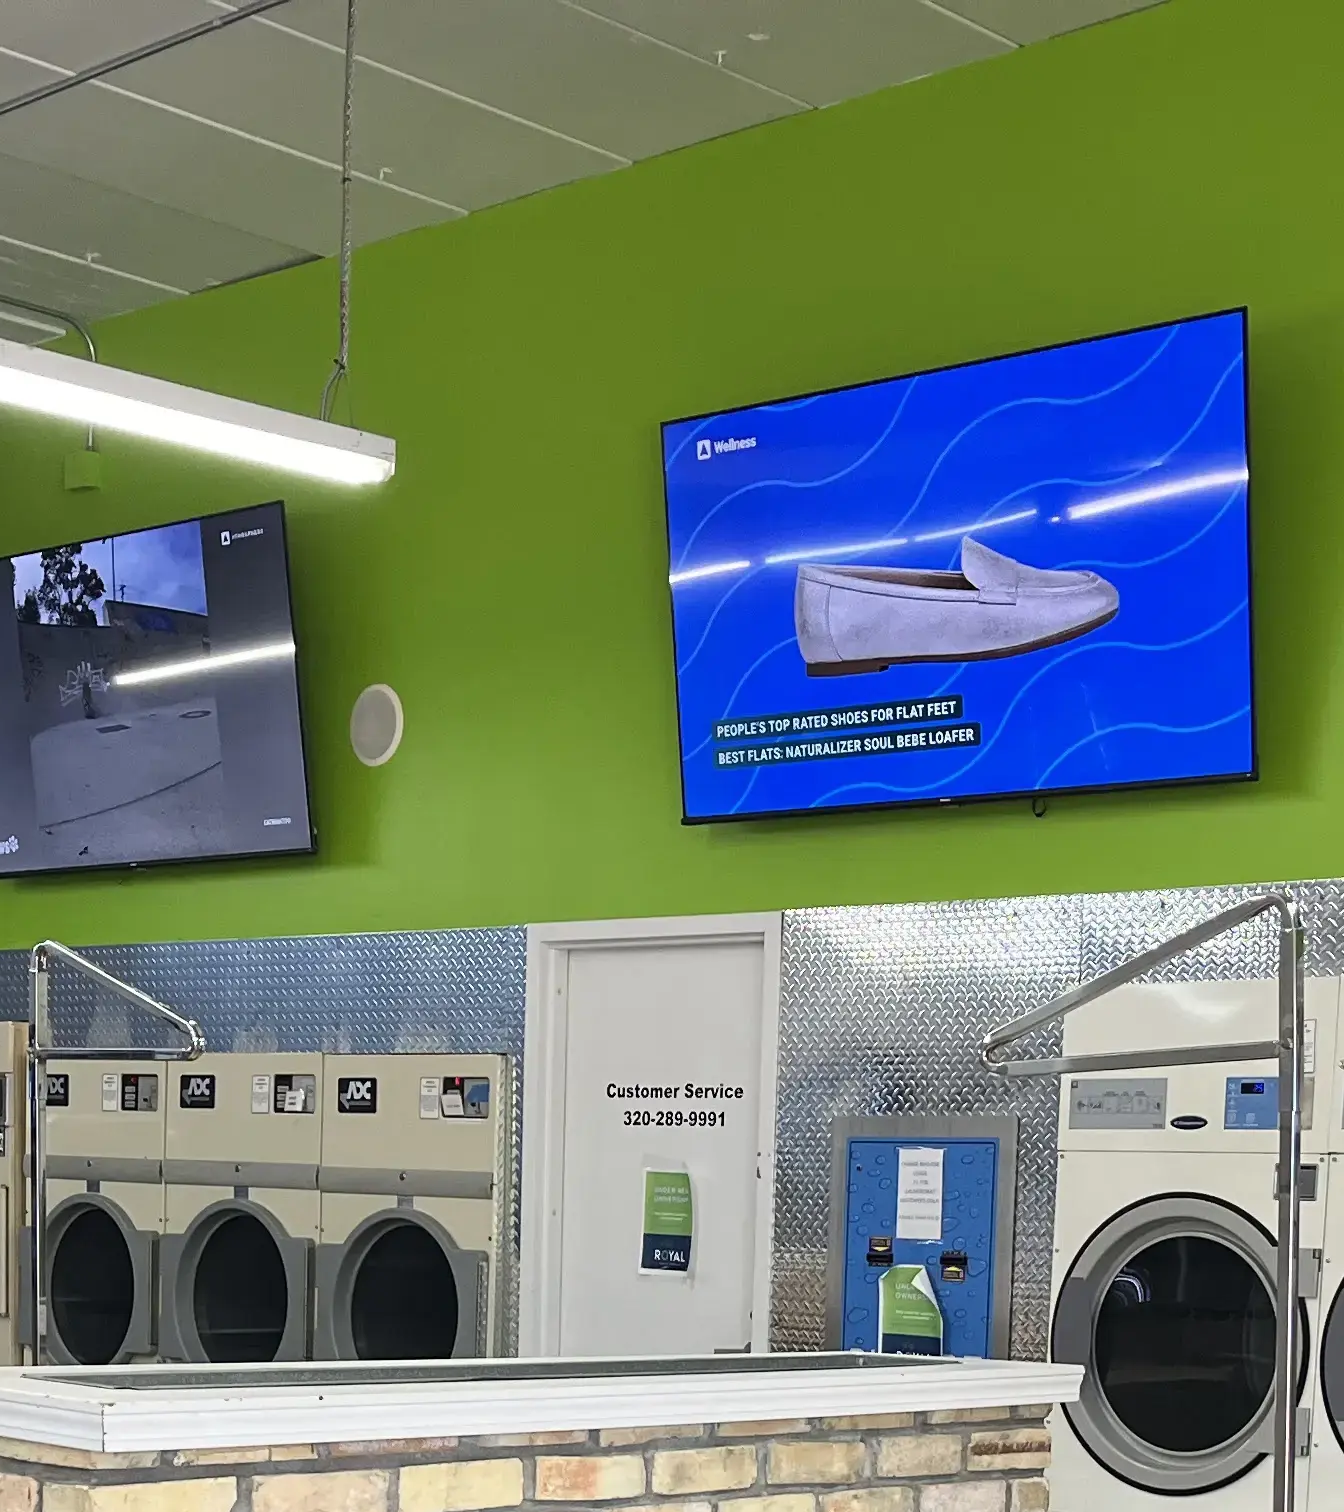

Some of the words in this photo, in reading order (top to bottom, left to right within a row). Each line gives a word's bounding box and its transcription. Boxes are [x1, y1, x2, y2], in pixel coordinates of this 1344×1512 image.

[714, 437, 757, 454] Wellness
[717, 721, 766, 738] PEOPLE'S
[768, 718, 790, 733] TOP
[792, 714, 828, 731] RATED
[830, 710, 869, 727] SHOES
[871, 707, 894, 722] FOR
[896, 704, 924, 720] FLAT
[927, 700, 956, 716] FEET
[718, 750, 745, 765] BEST
[747, 747, 784, 762] FLATS:
[785, 739, 862, 758] NATURALIZER
[864, 736, 894, 751] SOUL
[896, 732, 926, 748] BEBE
[929, 728, 975, 746] LOAFER
[606, 1083, 680, 1098] Customer
[684, 1083, 744, 1099] Service
[623, 1111, 725, 1127] 320-289-9991
[653, 1249, 686, 1263] ROYAL
